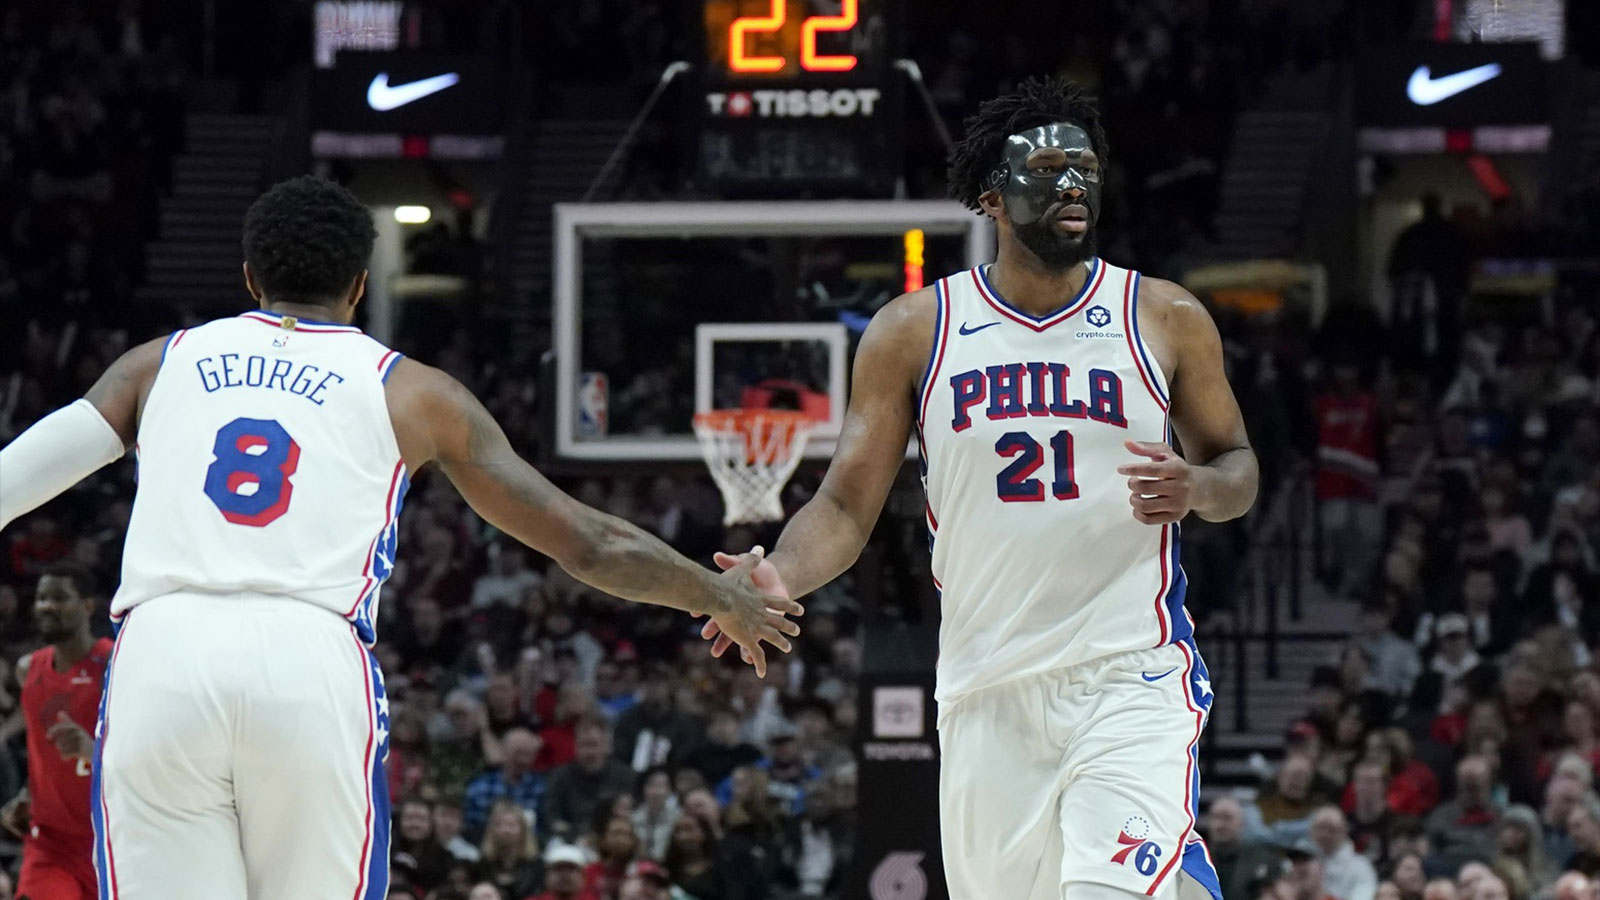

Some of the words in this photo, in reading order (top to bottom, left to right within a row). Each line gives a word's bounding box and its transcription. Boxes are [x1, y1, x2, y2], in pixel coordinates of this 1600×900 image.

[729, 0, 858, 72] 22
[752, 88, 881, 117] TISSOT
[1076, 331, 1124, 339] crypto.com
[196, 353, 345, 406] GEORGE
[949, 361, 1128, 433] PHILA
[203, 416, 301, 528] 8
[994, 429, 1080, 503] 21
[1110, 829, 1163, 877] 76
